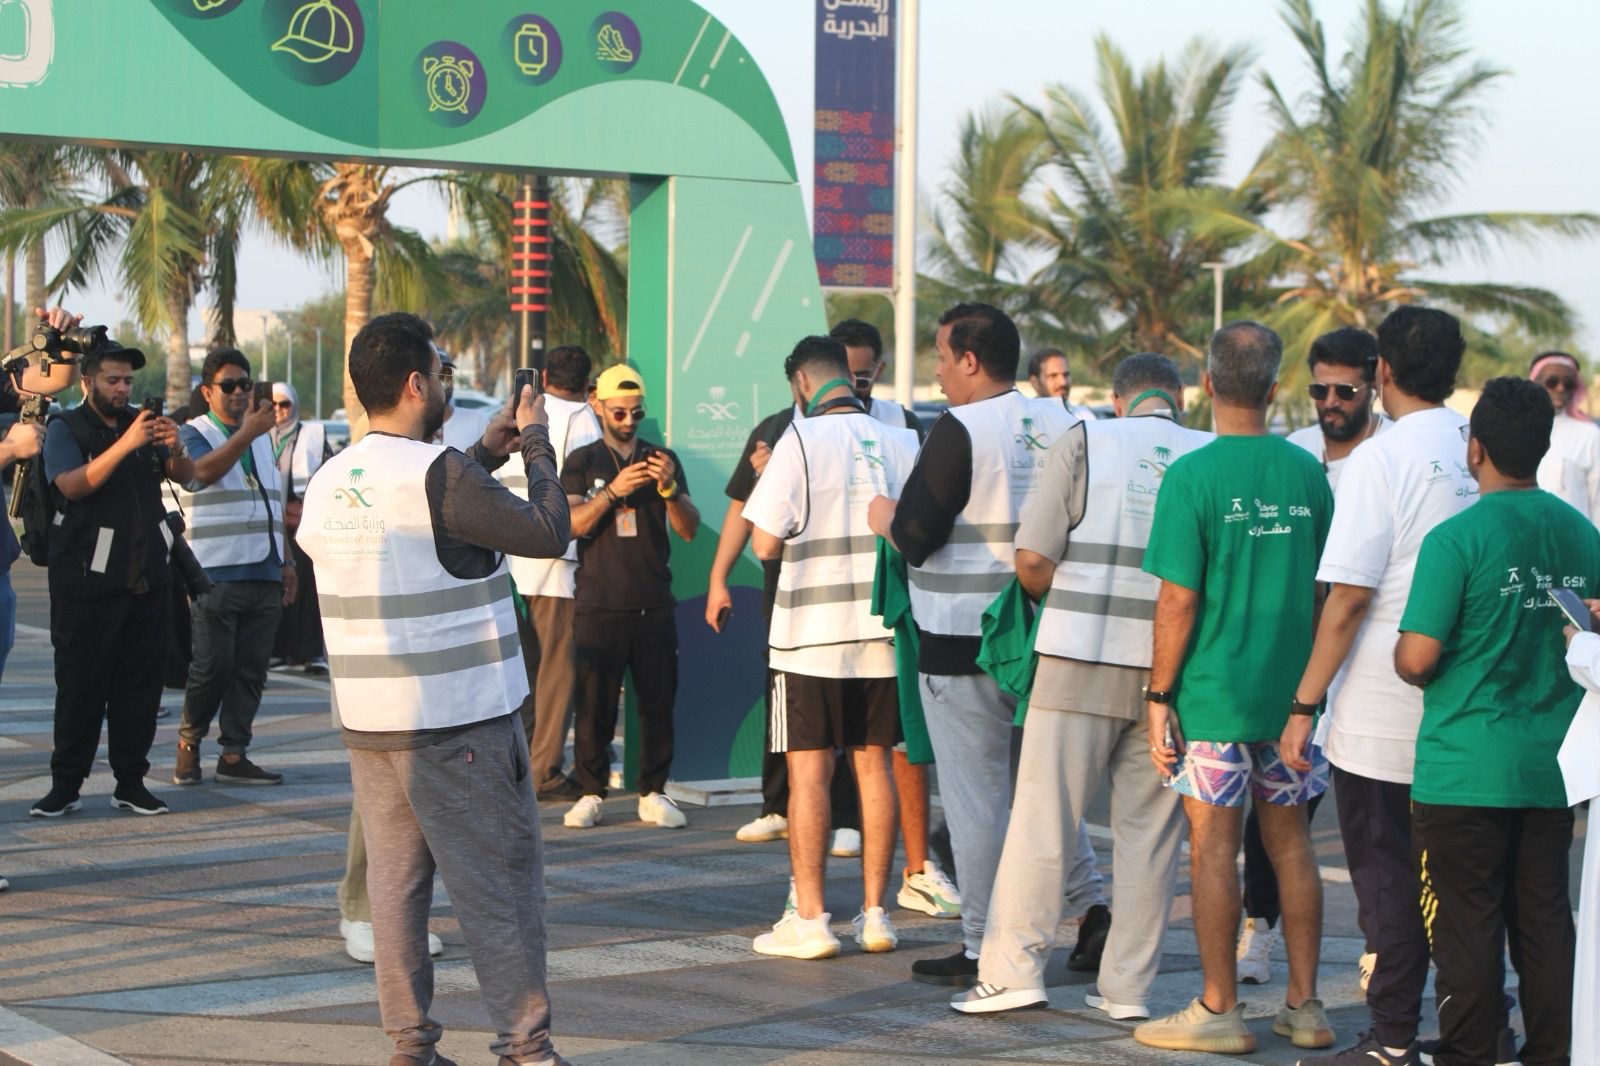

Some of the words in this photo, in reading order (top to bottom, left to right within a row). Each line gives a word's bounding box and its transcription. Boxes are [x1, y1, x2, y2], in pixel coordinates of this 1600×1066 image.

[823, 13, 889, 41] البحرية
[1127, 480, 1160, 496] صحة
[1289, 505, 1312, 517] GSK
[323, 512, 361, 530] الصحة
[361, 513, 386, 533] وزارة
[1248, 522, 1292, 537] مشارك
[1562, 576, 1587, 588] GSK
[1523, 596, 1559, 611] شارك
